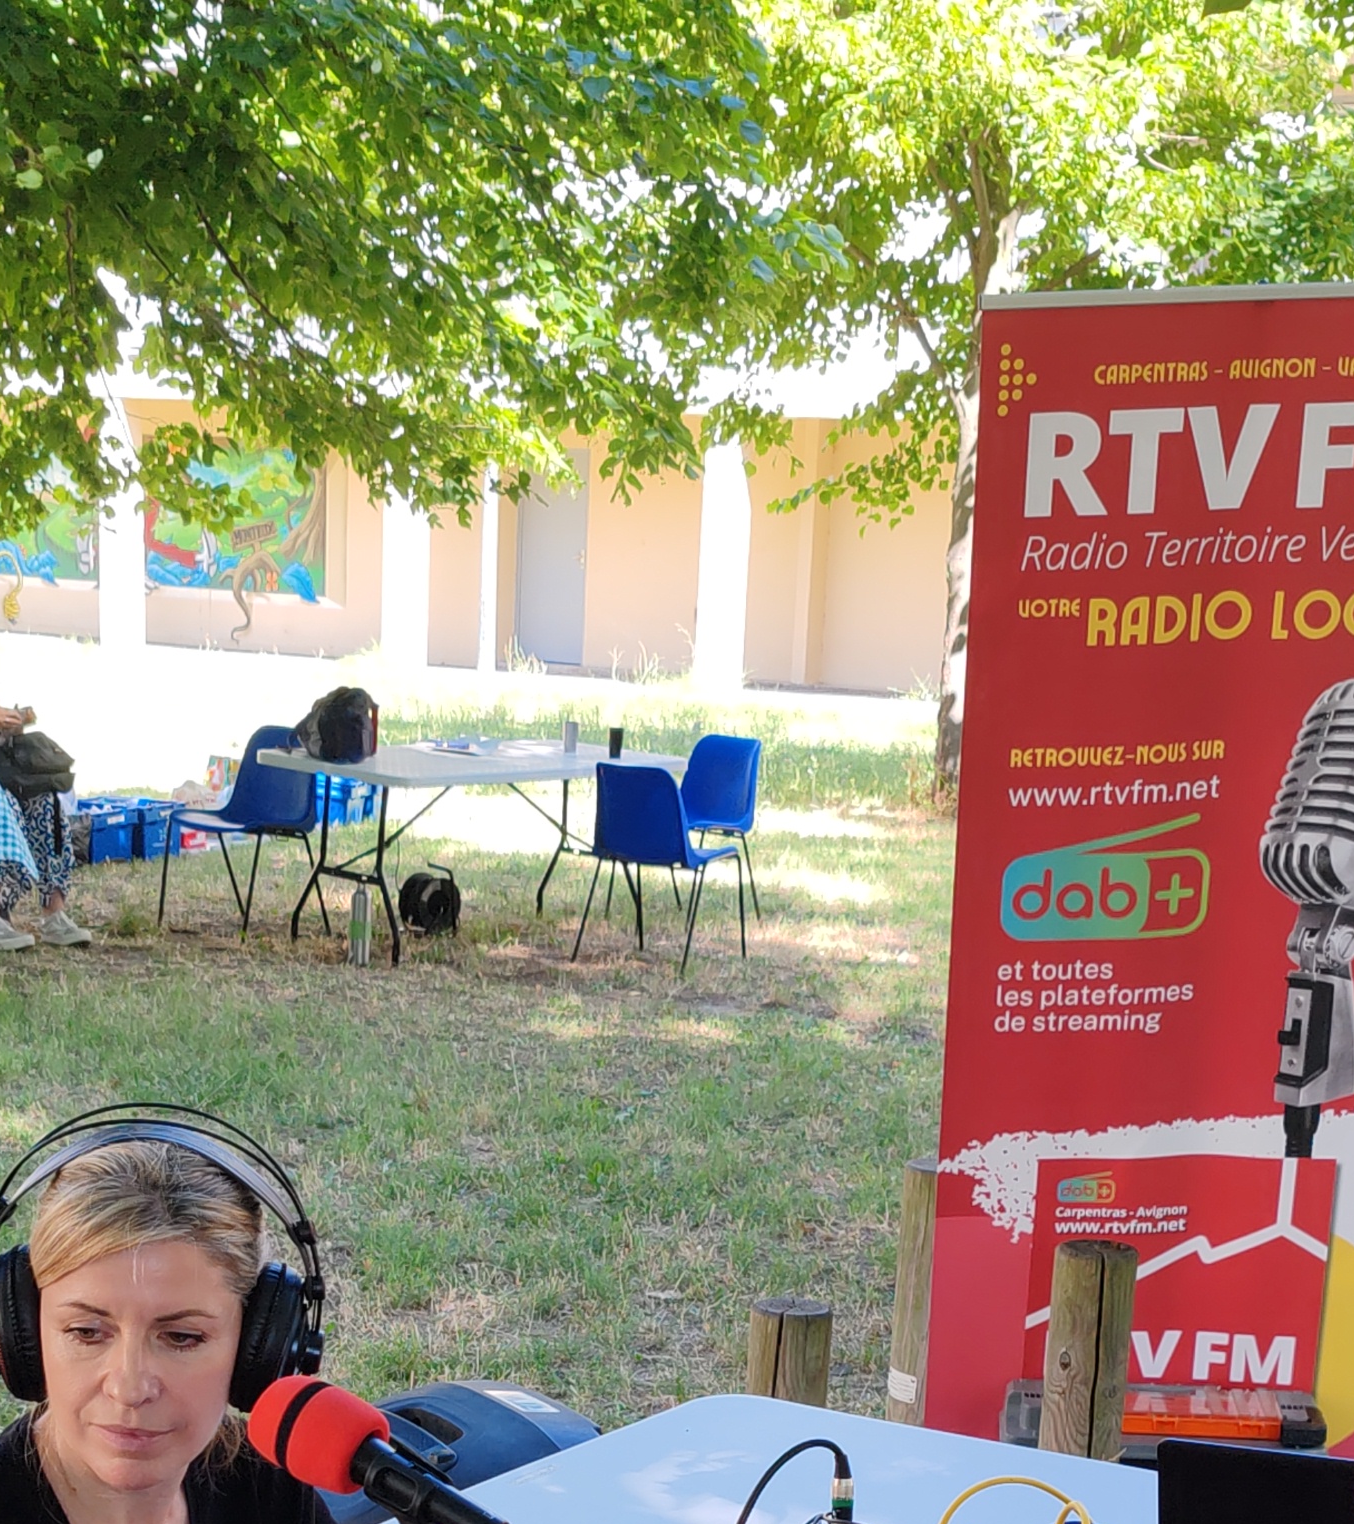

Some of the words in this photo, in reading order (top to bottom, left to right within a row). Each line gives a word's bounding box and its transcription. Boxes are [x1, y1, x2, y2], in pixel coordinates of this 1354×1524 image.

[1094, 362, 1209, 385] CARPENTRAS
[1229, 357, 1316, 381] AVIGNON
[1023, 403, 1281, 518] RTV
[1021, 533, 1129, 572] Radio
[1145, 526, 1307, 568] Territoire
[1018, 598, 1081, 618] VOTRE
[1086, 589, 1252, 647] RADIO
[1009, 742, 1188, 768] RETROUVEZ-NOUS
[1192, 740, 1225, 761] SUR
[1008, 774, 1221, 808] www.rtvfm.net
[997, 961, 1024, 982] et
[1031, 959, 1114, 981] toutes
[996, 985, 1034, 1008] les
[1040, 981, 1194, 1009] plateformes
[994, 1011, 1025, 1033] de
[1032, 1011, 1161, 1034] streaming
[1055, 1206, 1128, 1220] Carpentras
[1136, 1205, 1188, 1219] Avignon
[1055, 1217, 1186, 1234] www.rtvfm.net
[1191, 1330, 1296, 1386] FM
